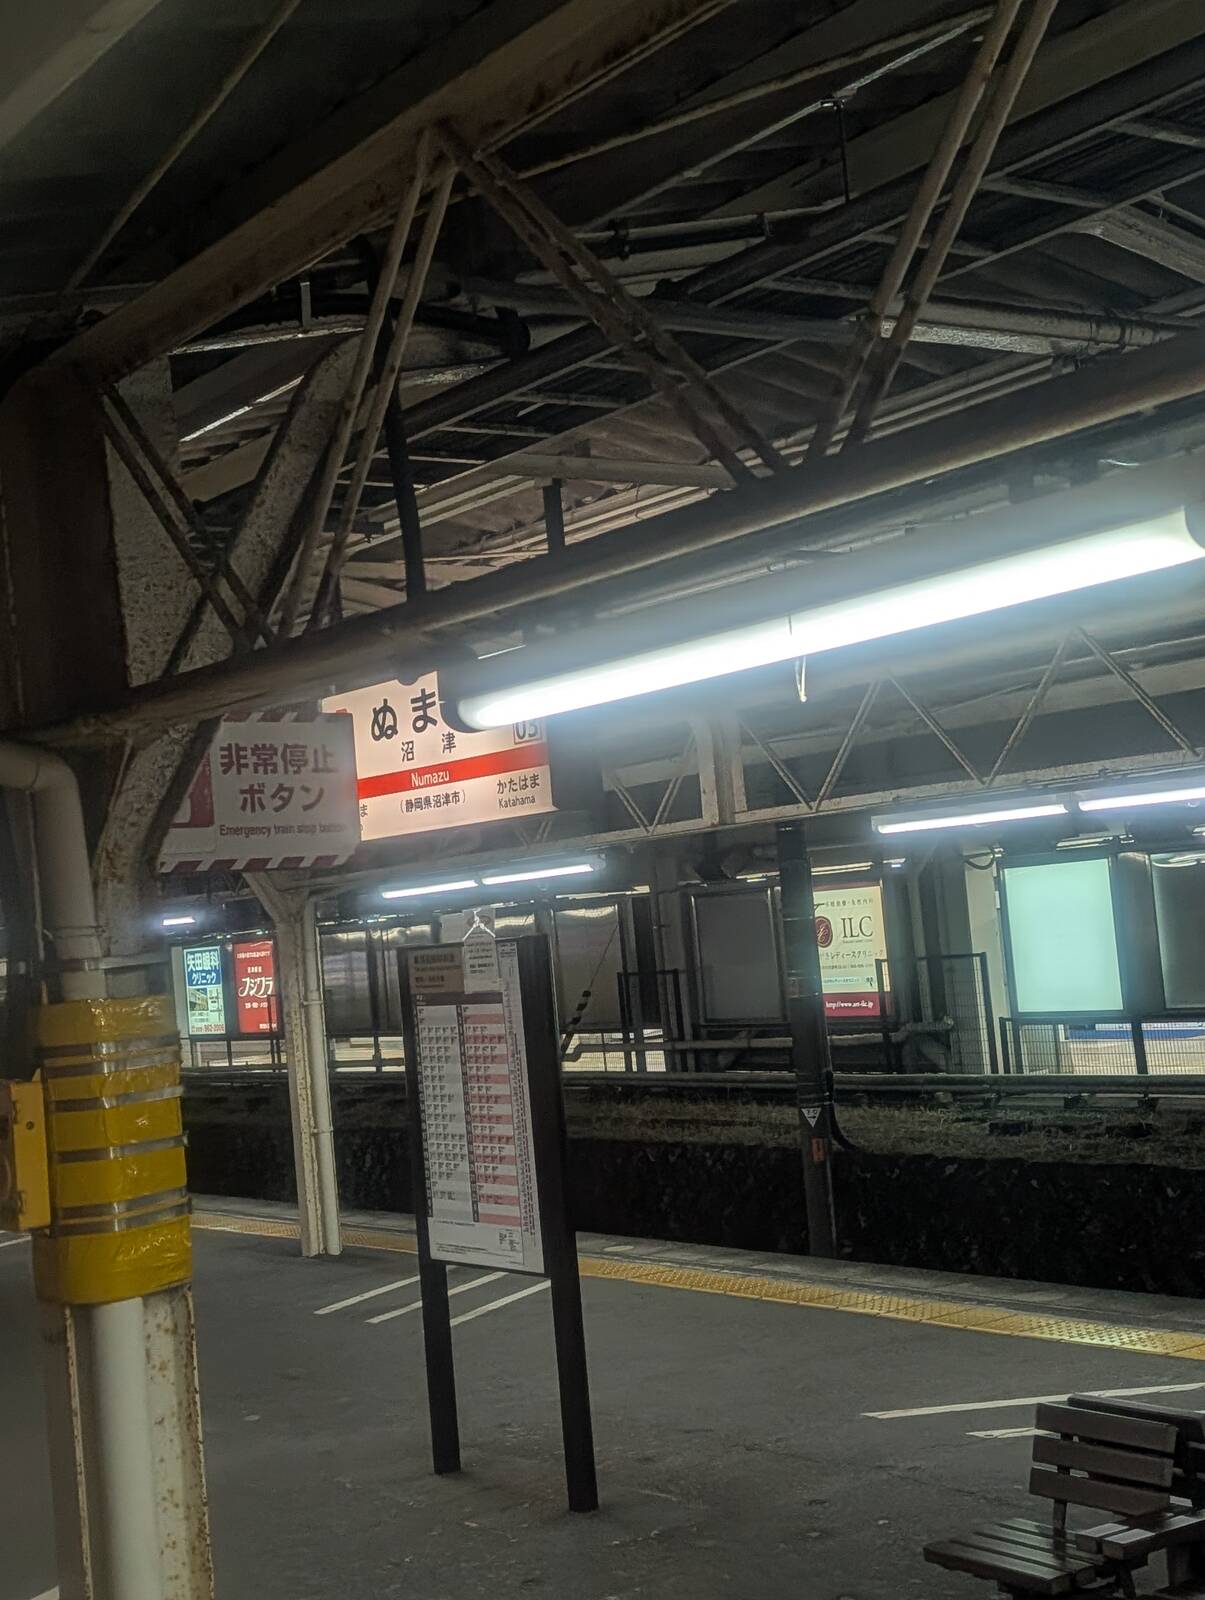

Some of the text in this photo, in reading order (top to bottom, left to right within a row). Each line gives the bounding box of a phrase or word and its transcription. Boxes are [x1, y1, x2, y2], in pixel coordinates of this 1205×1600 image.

[219, 743, 338, 775] 非常停止
[411, 769, 450, 787] Numazu
[496, 773, 540, 795] かたはま
[239, 782, 325, 813] ボタン
[498, 795, 536, 809] Katahama
[219, 824, 272, 838] Emergency
[274, 823, 295, 835] train
[840, 915, 874, 938] ILC
[187, 950, 220, 972] 矢田眼科
[191, 972, 217, 985] クリニック
